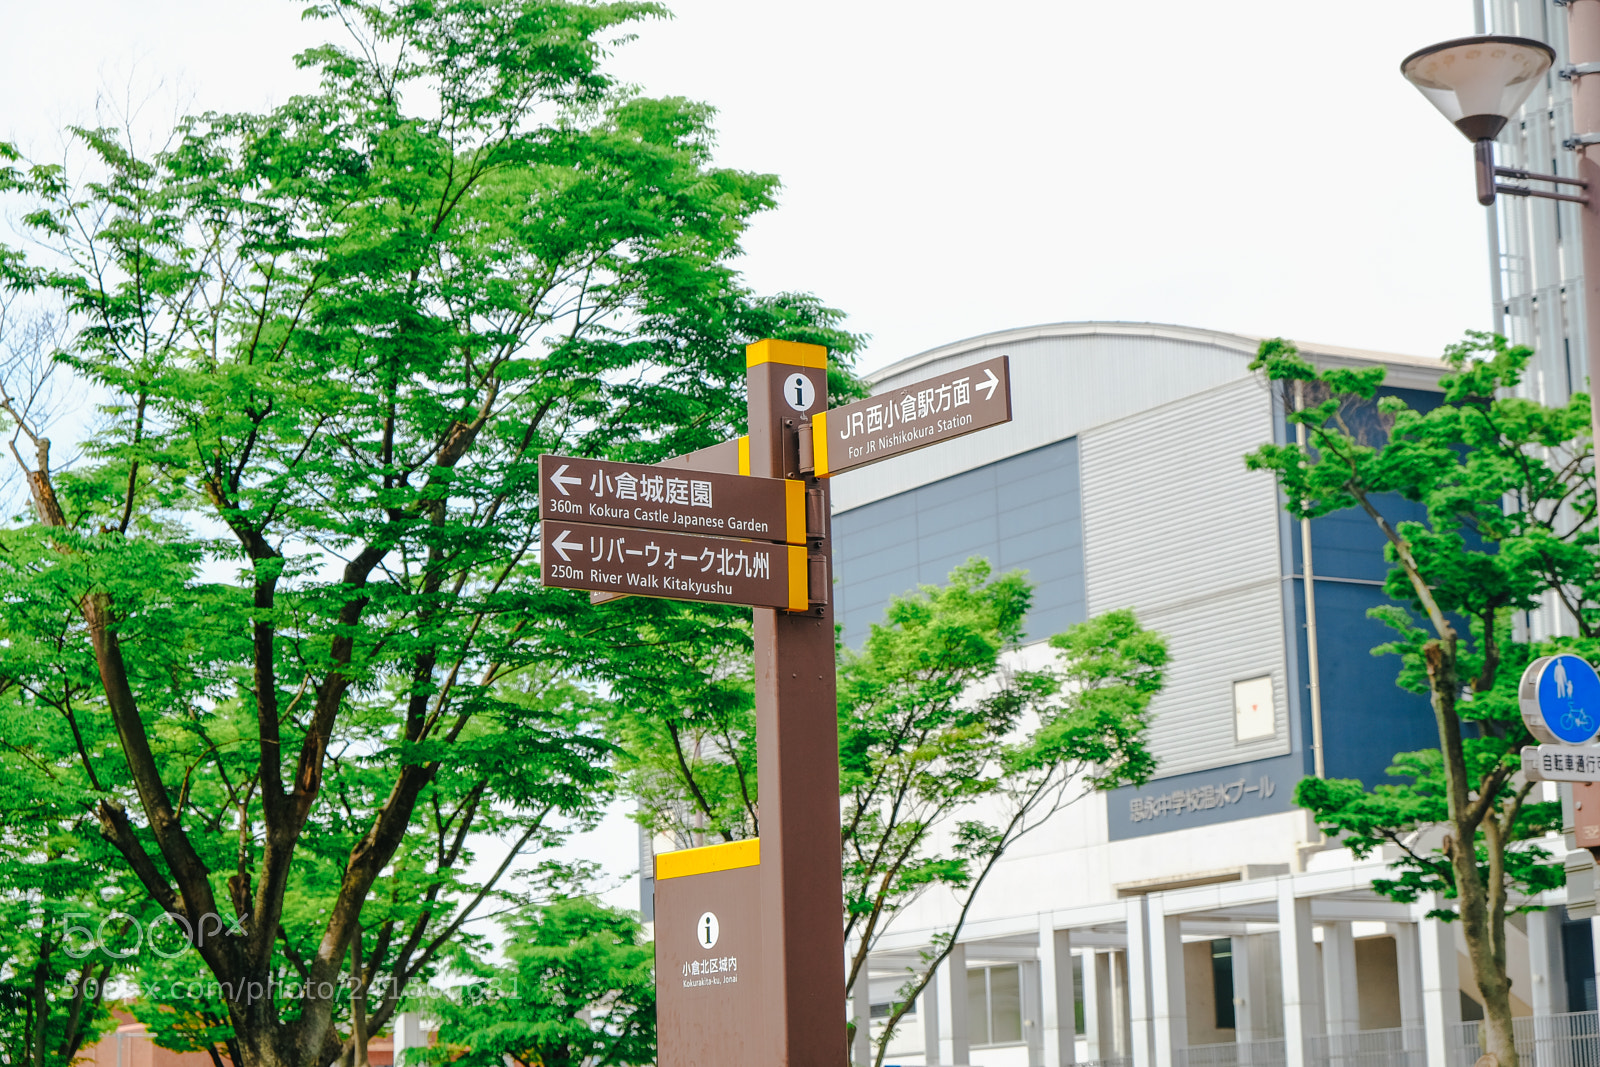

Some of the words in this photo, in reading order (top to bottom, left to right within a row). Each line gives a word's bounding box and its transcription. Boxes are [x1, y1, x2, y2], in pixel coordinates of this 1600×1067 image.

[840, 376, 970, 440] JR西小倉駅方面
[848, 446, 864, 459] For
[865, 440, 876, 454] JR
[878, 425, 934, 450] Nishikokura
[937, 413, 973, 433] Station
[589, 469, 713, 509] 小倉城庭園
[550, 499, 583, 515] 360m
[589, 503, 630, 520] Kokura
[634, 507, 669, 523] Castle
[672, 512, 724, 529] Japanese
[727, 517, 769, 533] Garden
[590, 536, 770, 580] リバーウォーク北九州
[551, 564, 584, 580] 250m
[590, 569, 623, 585] River
[626, 573, 659, 589] Walk
[663, 576, 733, 596] Kitakyushu
[682, 956, 738, 977] 小倉北区城内
[682, 976, 722, 988] Kokurakita-ku,
[723, 974, 738, 984] Jonai
